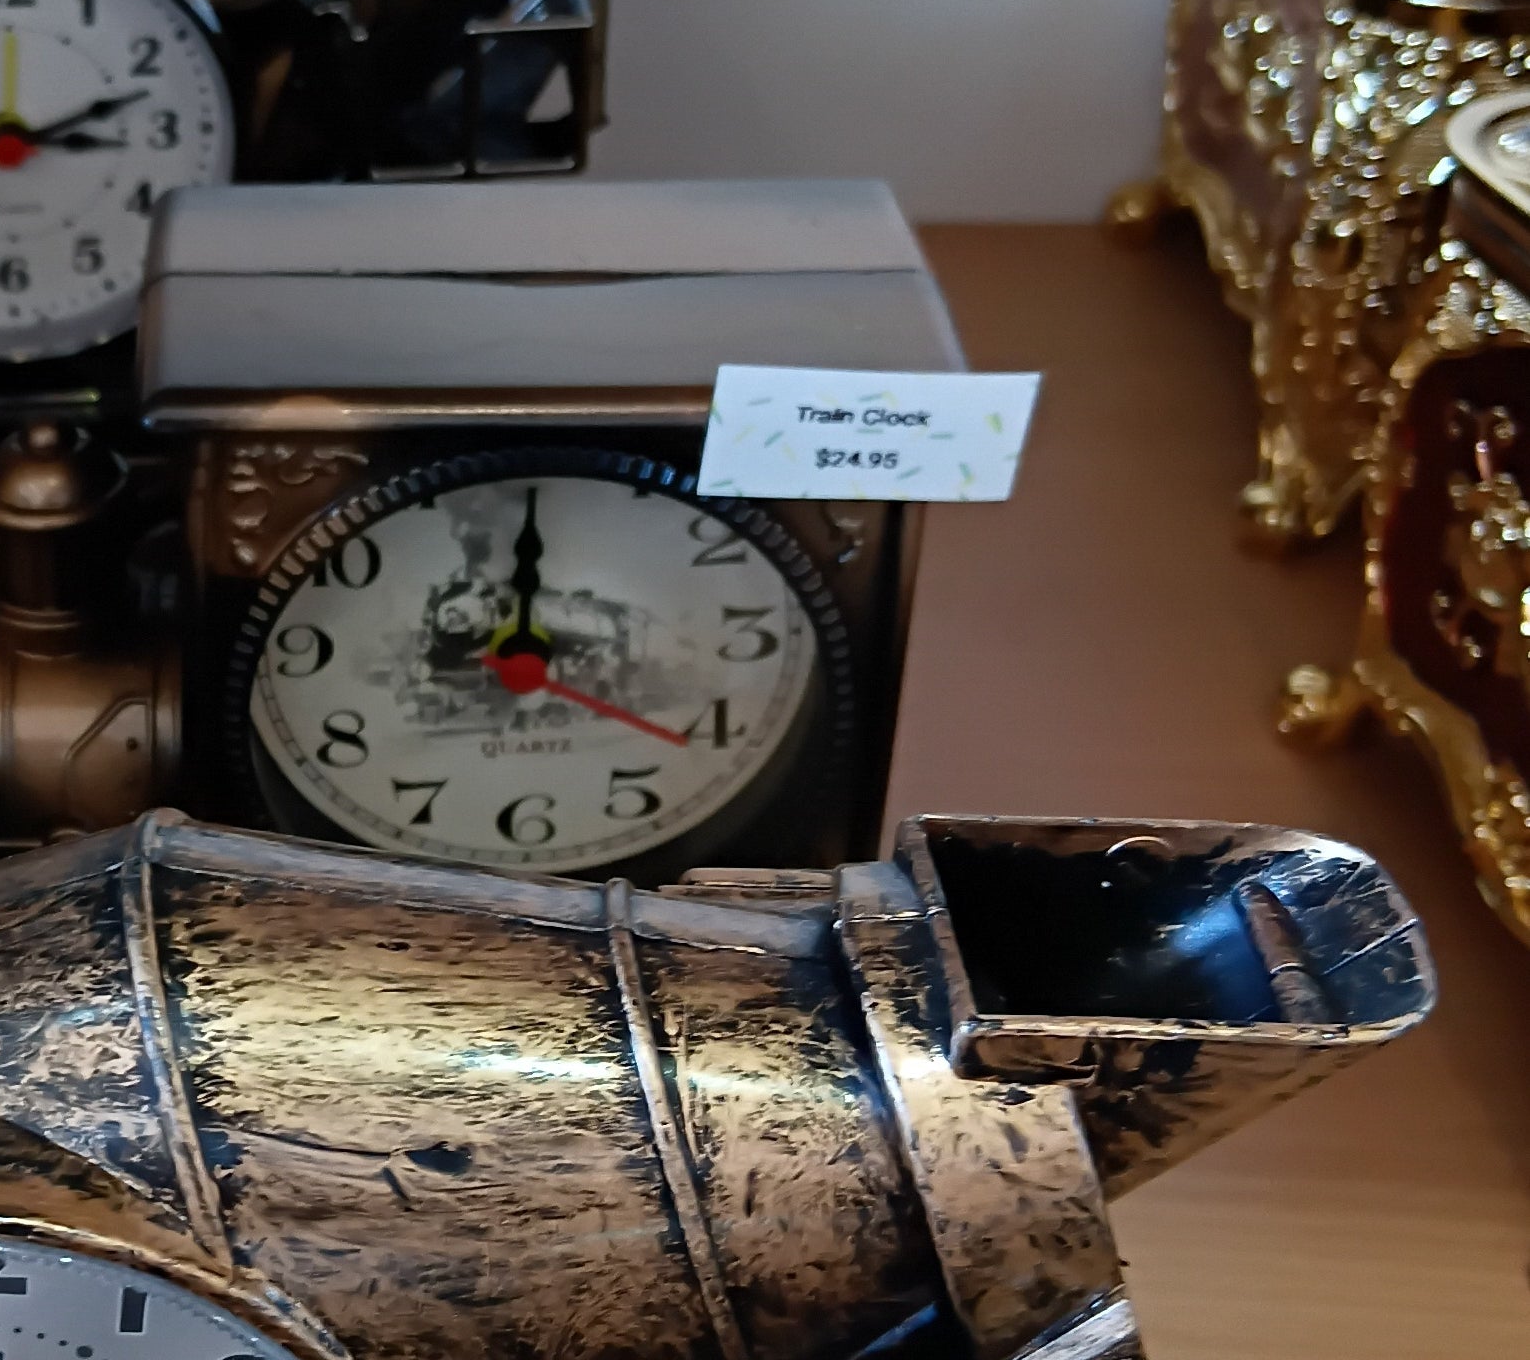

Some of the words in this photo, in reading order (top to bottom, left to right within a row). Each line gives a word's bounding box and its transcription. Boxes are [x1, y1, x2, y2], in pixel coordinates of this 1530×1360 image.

[132, 38, 162, 76] 2
[150, 112, 180, 149] 3
[127, 182, 158, 216] 4
[75, 239, 104, 275] 5
[798, 406, 855, 424] Train
[862, 408, 931, 427] Clock
[815, 448, 899, 470] $24.95
[690, 516, 747, 567] 2
[276, 624, 333, 678] 9
[719, 607, 779, 663] 3
[317, 710, 368, 768] 8
[688, 698, 746, 750] 4
[392, 778, 449, 826] 7
[605, 765, 661, 820] 5
[496, 793, 556, 843] 6
